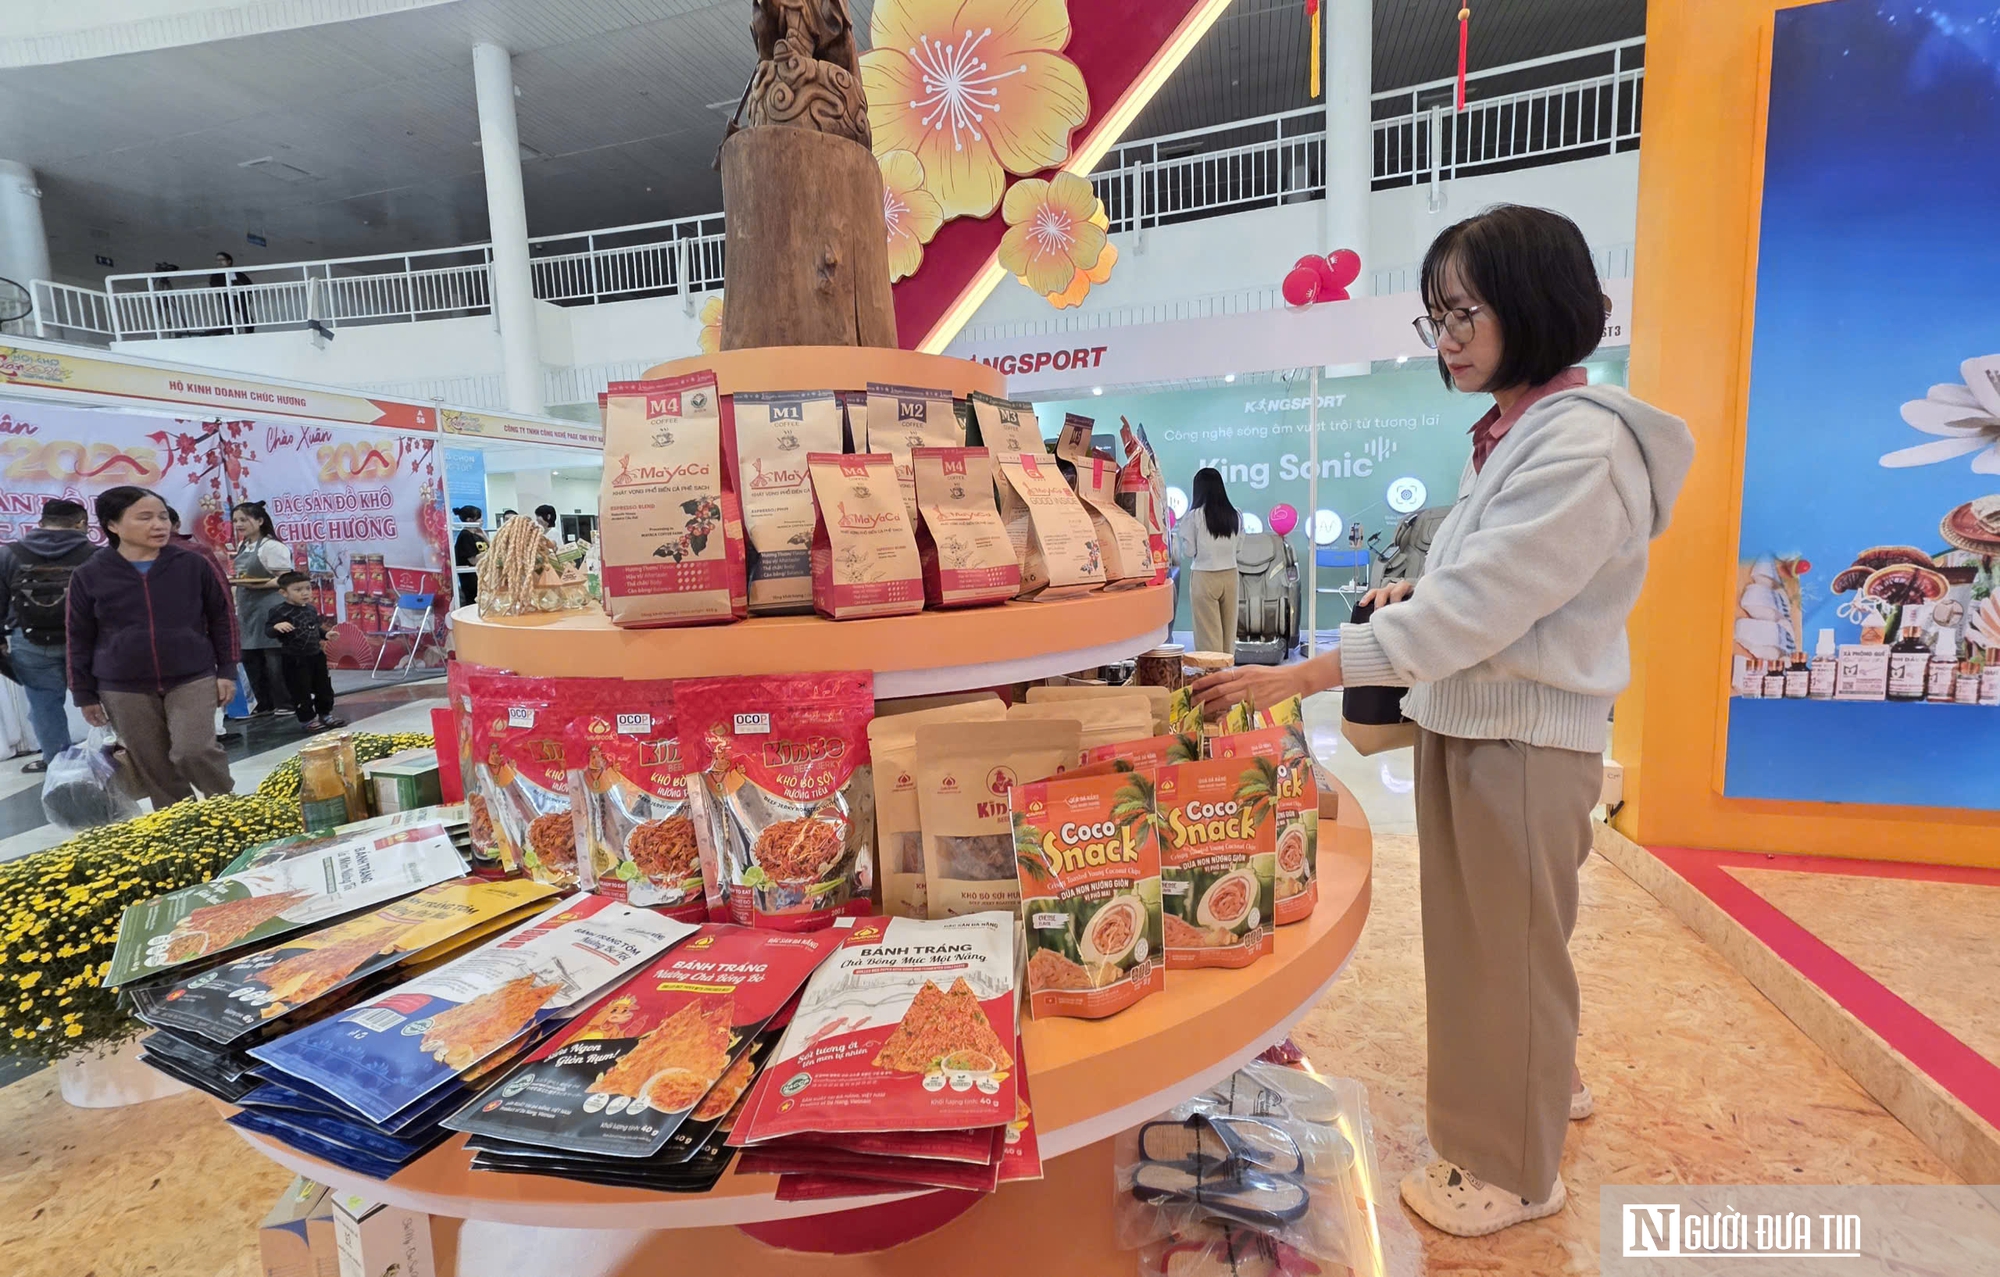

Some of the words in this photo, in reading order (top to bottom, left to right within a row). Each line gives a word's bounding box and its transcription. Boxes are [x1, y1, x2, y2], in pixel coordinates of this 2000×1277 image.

[970, 346, 1108, 376] NGSPORT
[169, 380, 184, 394] HỘ
[186, 383, 212, 395] KINH
[214, 386, 248, 399] DOANH
[250, 391, 275, 402] CHÚC
[276, 394, 307, 407] HƯƠNG
[650, 397, 679, 415] M4
[772, 406, 799, 419] M1
[901, 404, 924, 418] M2
[1000, 409, 1018, 422] M3
[1164, 428, 1199, 443] Công
[1202, 425, 1233, 442] nghệ
[1236, 421, 1268, 439] sóng
[1271, 420, 1293, 434] âm
[1422, 413, 1441, 427] lai
[266, 426, 294, 453] Chào
[296, 425, 332, 452] Xuân
[944, 460, 963, 473] M4
[1279, 450, 1373, 480] Sonic
[273, 493, 304, 517] ĐẶC
[303, 489, 334, 512] SẢN
[335, 486, 359, 511] ĐỒ
[359, 486, 393, 509] KHÔ
[276, 517, 326, 542] CHÚC
[328, 515, 397, 540] HƯƠNG
[510, 708, 532, 719] OCOP
[618, 715, 648, 725] OCOP
[736, 714, 770, 725] OCOP
[651, 772, 670, 786] KHÔ
[673, 773, 687, 787] BÒ
[775, 770, 798, 788] KHÔ
[799, 775, 815, 788] BÒ
[1186, 800, 1238, 821] Coco
[1060, 820, 1115, 845] Coco
[1168, 805, 1256, 849] Snack
[1041, 825, 1139, 879] Snack
[1075, 882, 1090, 894] NON
[961, 891, 977, 900] KHÔ
[621, 942, 642, 956] TÔM
[860, 946, 909, 957] BÁNH
[913, 943, 973, 955] TRÁNG
[671, 959, 717, 971] BÁNH
[717, 961, 768, 973] TRÁNG
[840, 957, 864, 969] Chà
[866, 956, 898, 967] Bông
[901, 955, 926, 966] Mực
[929, 955, 952, 965] Một
[953, 952, 987, 963] Nắng
[652, 969, 691, 982] Nướng
[570, 1043, 603, 1055] Ngon
[815, 1043, 846, 1056] tương
[815, 1055, 834, 1063] men
[980, 1097, 991, 1105] 40
[640, 1124, 653, 1133] 40
[685, 1136, 692, 1145] g
[711, 1148, 719, 1156] g
